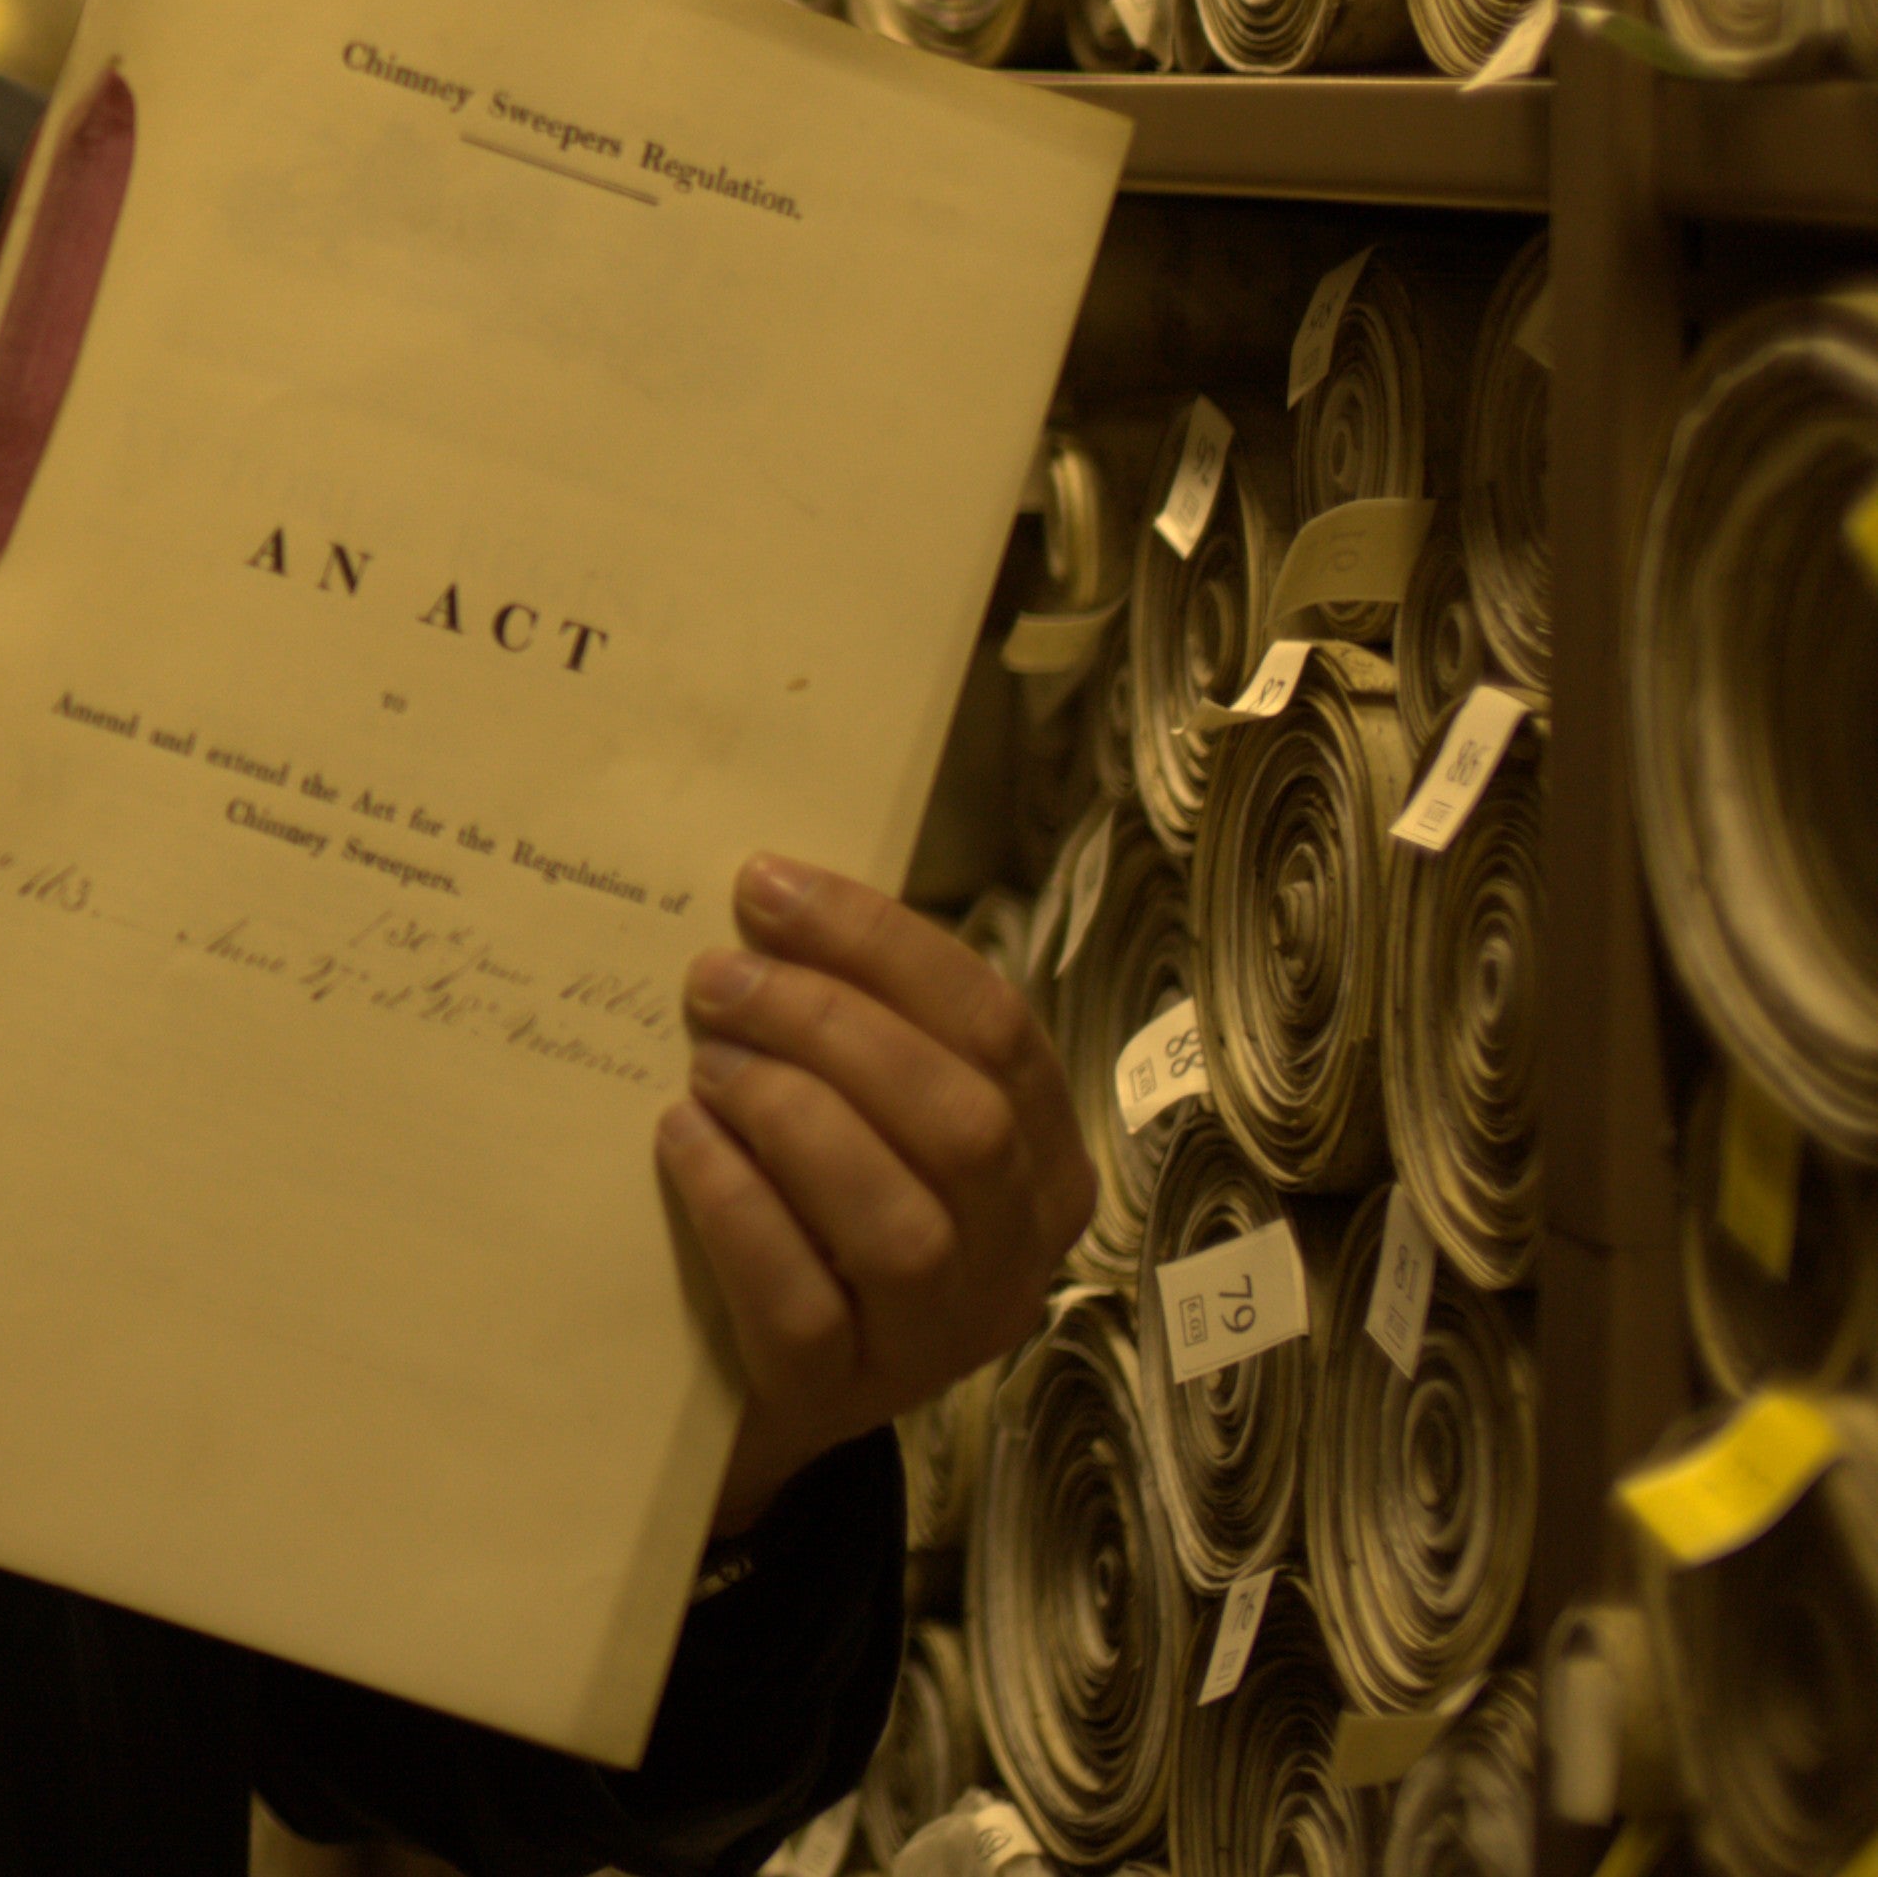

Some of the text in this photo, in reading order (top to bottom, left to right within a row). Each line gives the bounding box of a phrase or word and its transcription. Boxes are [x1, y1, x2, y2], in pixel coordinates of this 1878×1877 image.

[343, 39, 804, 221] Chimney Sweepers Regulation.
[245, 526, 609, 674] AN ACT
[53, 691, 692, 917] Amend and extend the Act for the Regulation of
[224, 796, 462, 897] Chimney Sweepers.
[1166, 1028, 1205, 1078] 88
[1218, 1274, 1257, 1335] 79
